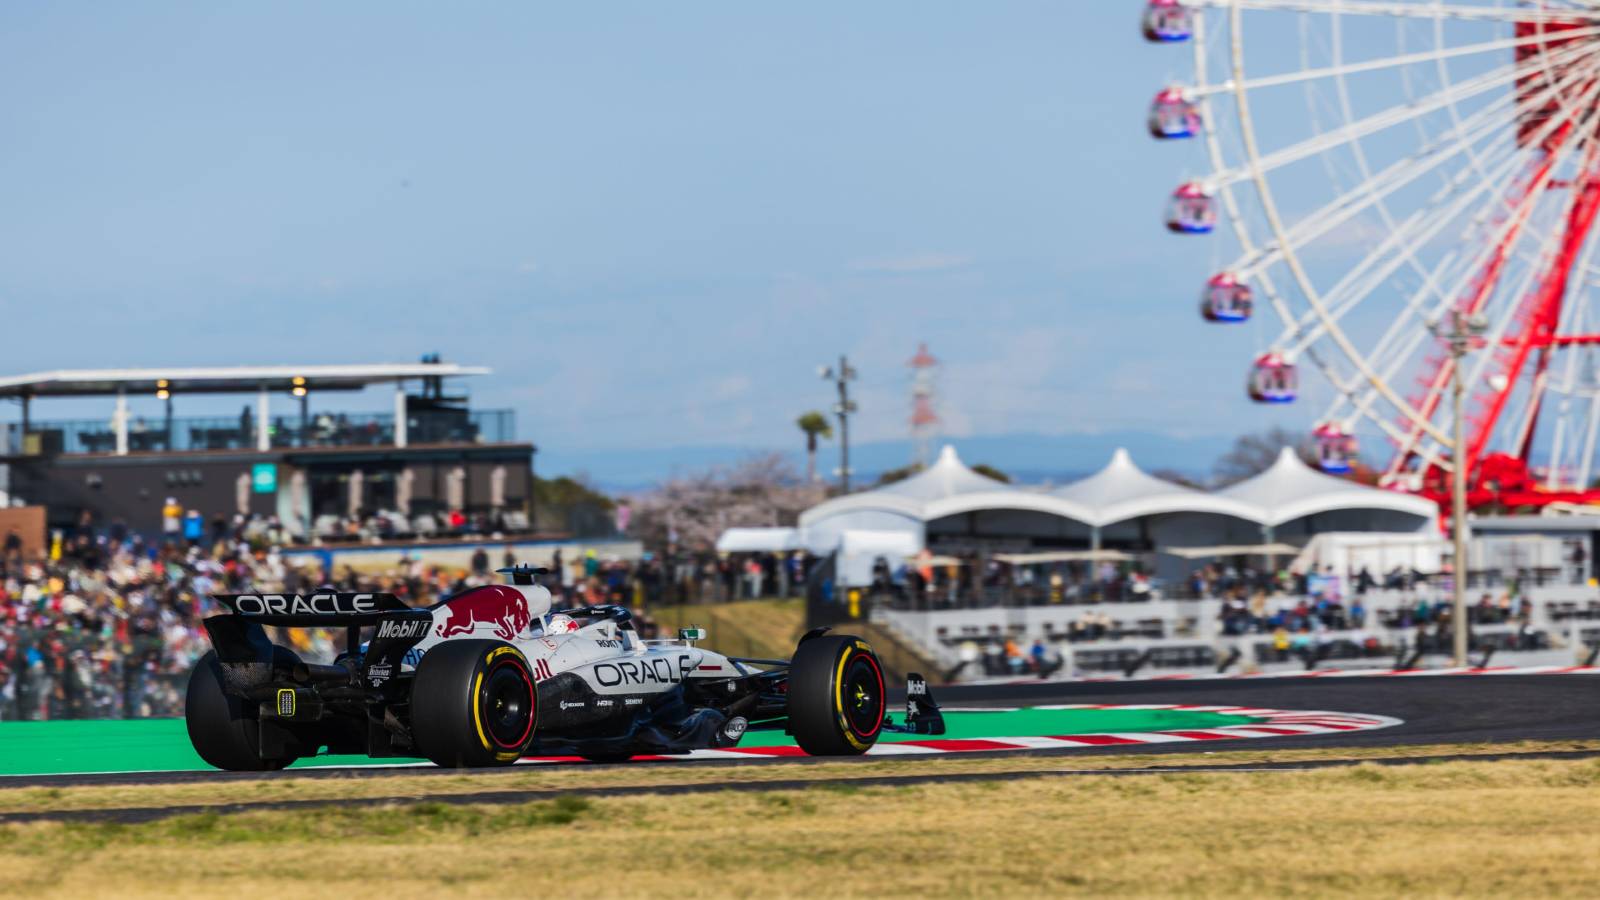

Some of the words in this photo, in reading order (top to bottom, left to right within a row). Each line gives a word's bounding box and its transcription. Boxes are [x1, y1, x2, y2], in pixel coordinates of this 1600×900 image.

[235, 594, 375, 614] ORACLE
[378, 620, 419, 638] Mobil
[593, 655, 691, 687] ORACLE
[907, 680, 926, 695] Mobil
